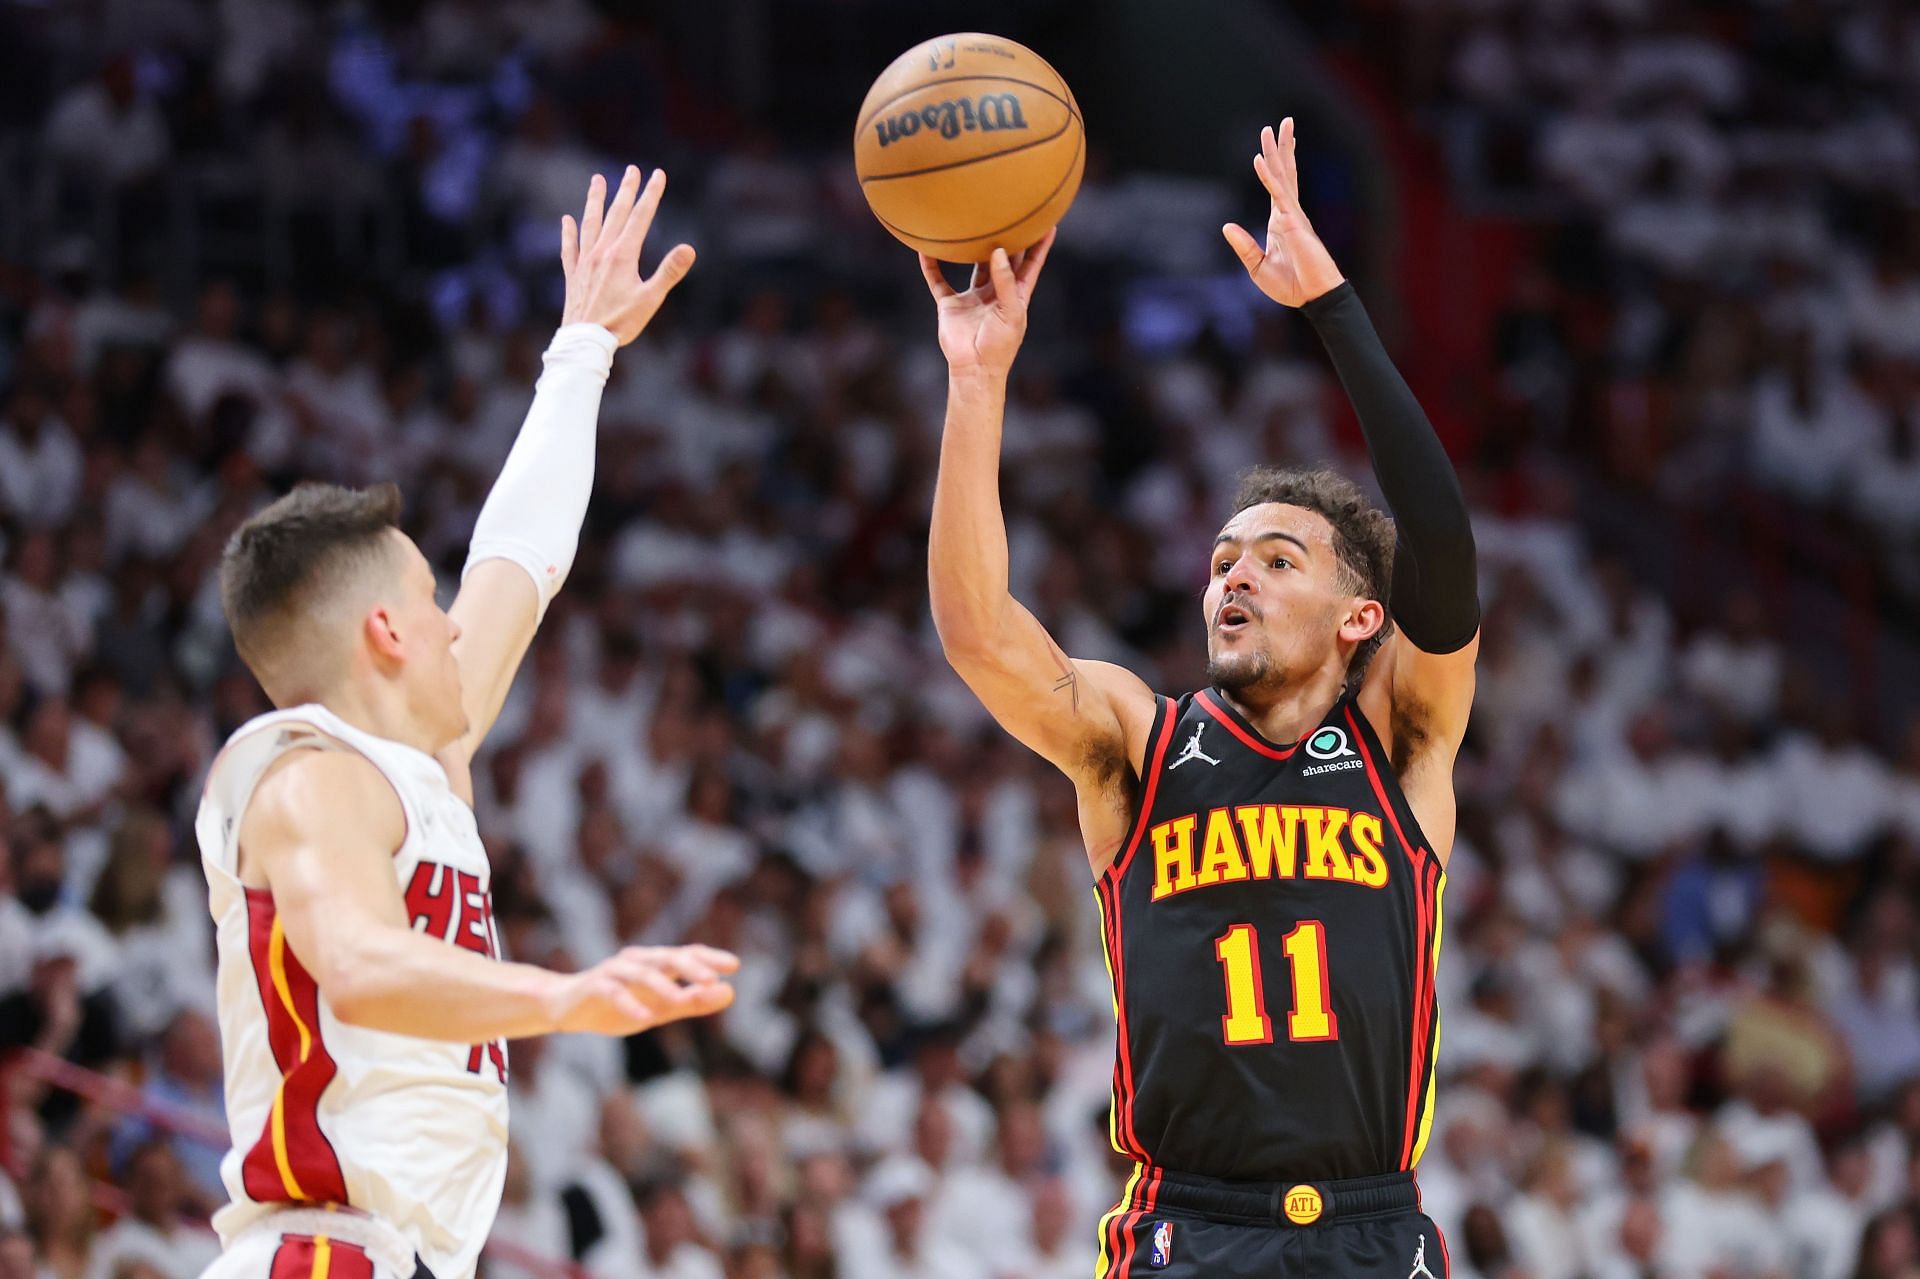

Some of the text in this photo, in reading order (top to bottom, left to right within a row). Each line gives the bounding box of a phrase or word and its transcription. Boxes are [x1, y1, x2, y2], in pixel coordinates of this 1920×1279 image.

[876, 94, 1028, 147] Wilson
[1302, 760, 1363, 777] sharecare
[1150, 804, 1389, 902] HAWKS
[1215, 919, 1338, 1046] 11
[1289, 1197, 1318, 1212] ATL
